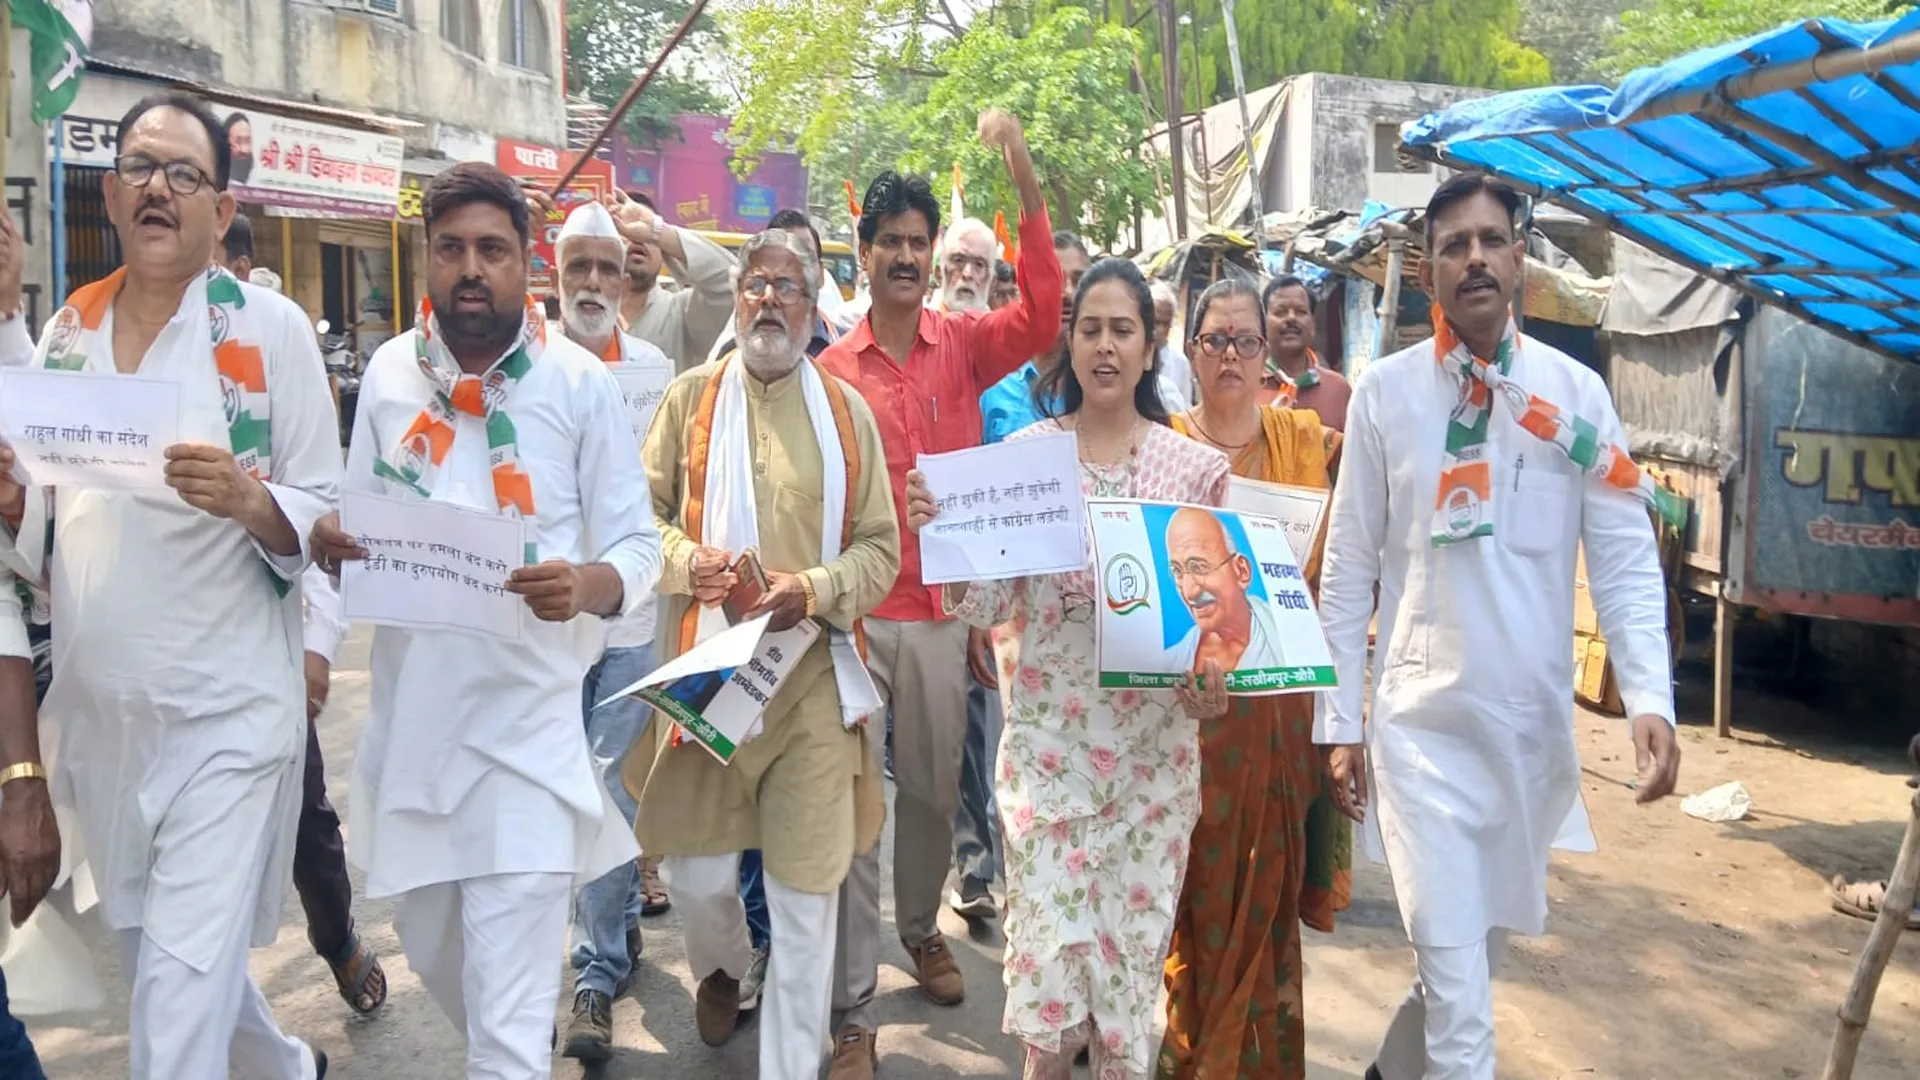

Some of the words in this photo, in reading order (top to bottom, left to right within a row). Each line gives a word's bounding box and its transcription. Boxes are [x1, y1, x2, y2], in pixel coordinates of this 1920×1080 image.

[513, 146, 559, 171] पाली
[24, 425, 56, 444] राहुल
[61, 424, 91, 443] गांधी
[97, 430, 112, 444] का
[117, 427, 149, 447] संदेश
[428, 543, 461, 561] हमला
[464, 550, 481, 567] बंद
[485, 559, 508, 575] करो
[392, 558, 408, 573] का
[462, 573, 480, 590] बंद
[482, 582, 504, 597] करो
